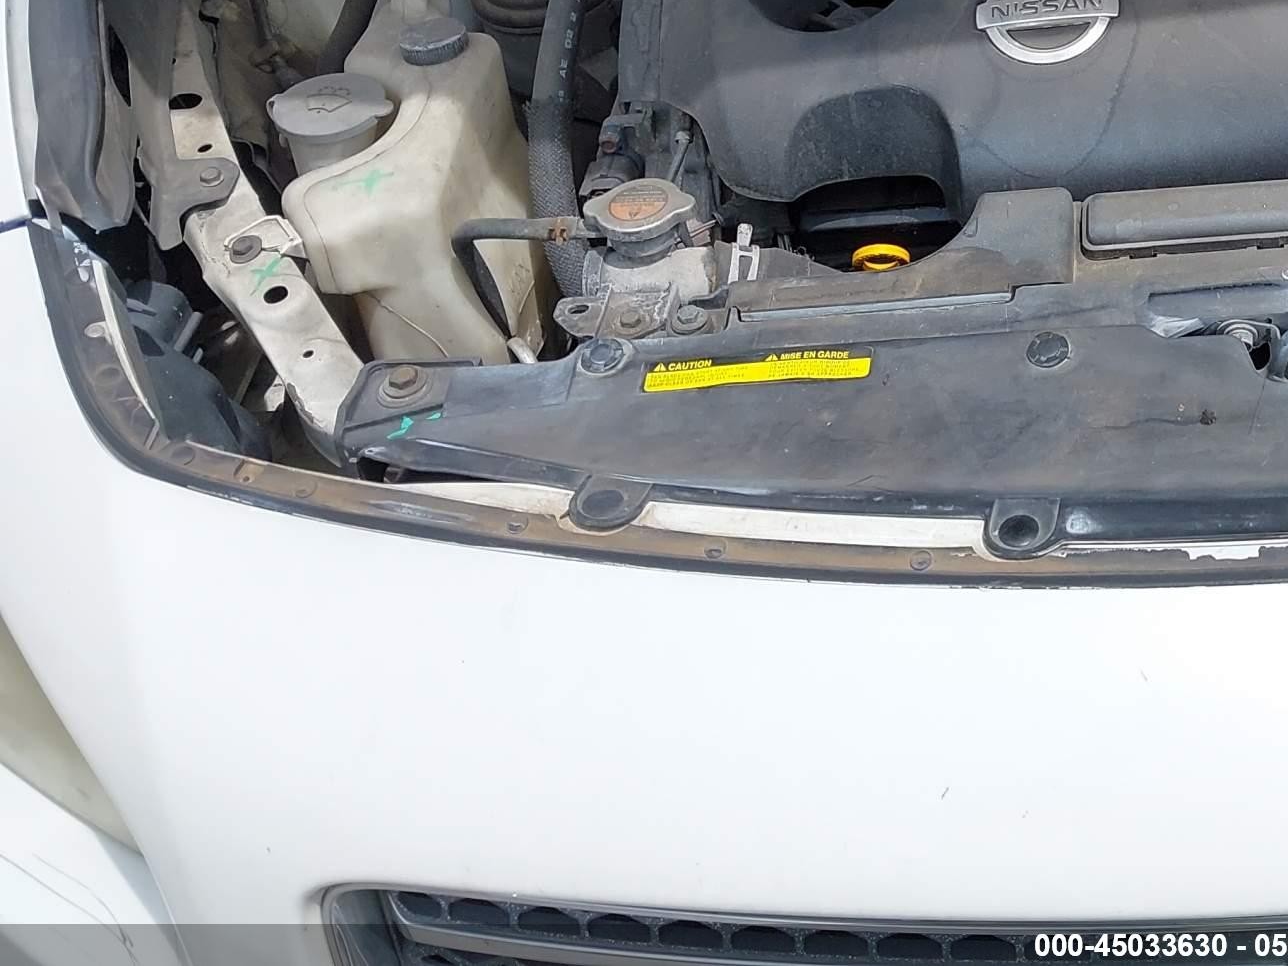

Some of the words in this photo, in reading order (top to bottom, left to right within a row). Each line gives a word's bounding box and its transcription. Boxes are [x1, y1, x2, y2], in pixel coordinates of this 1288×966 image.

[779, 352, 801, 361] MISE
[803, 351, 817, 359] EN
[817, 350, 850, 360] GARDE
[667, 359, 712, 371] CAUTION
